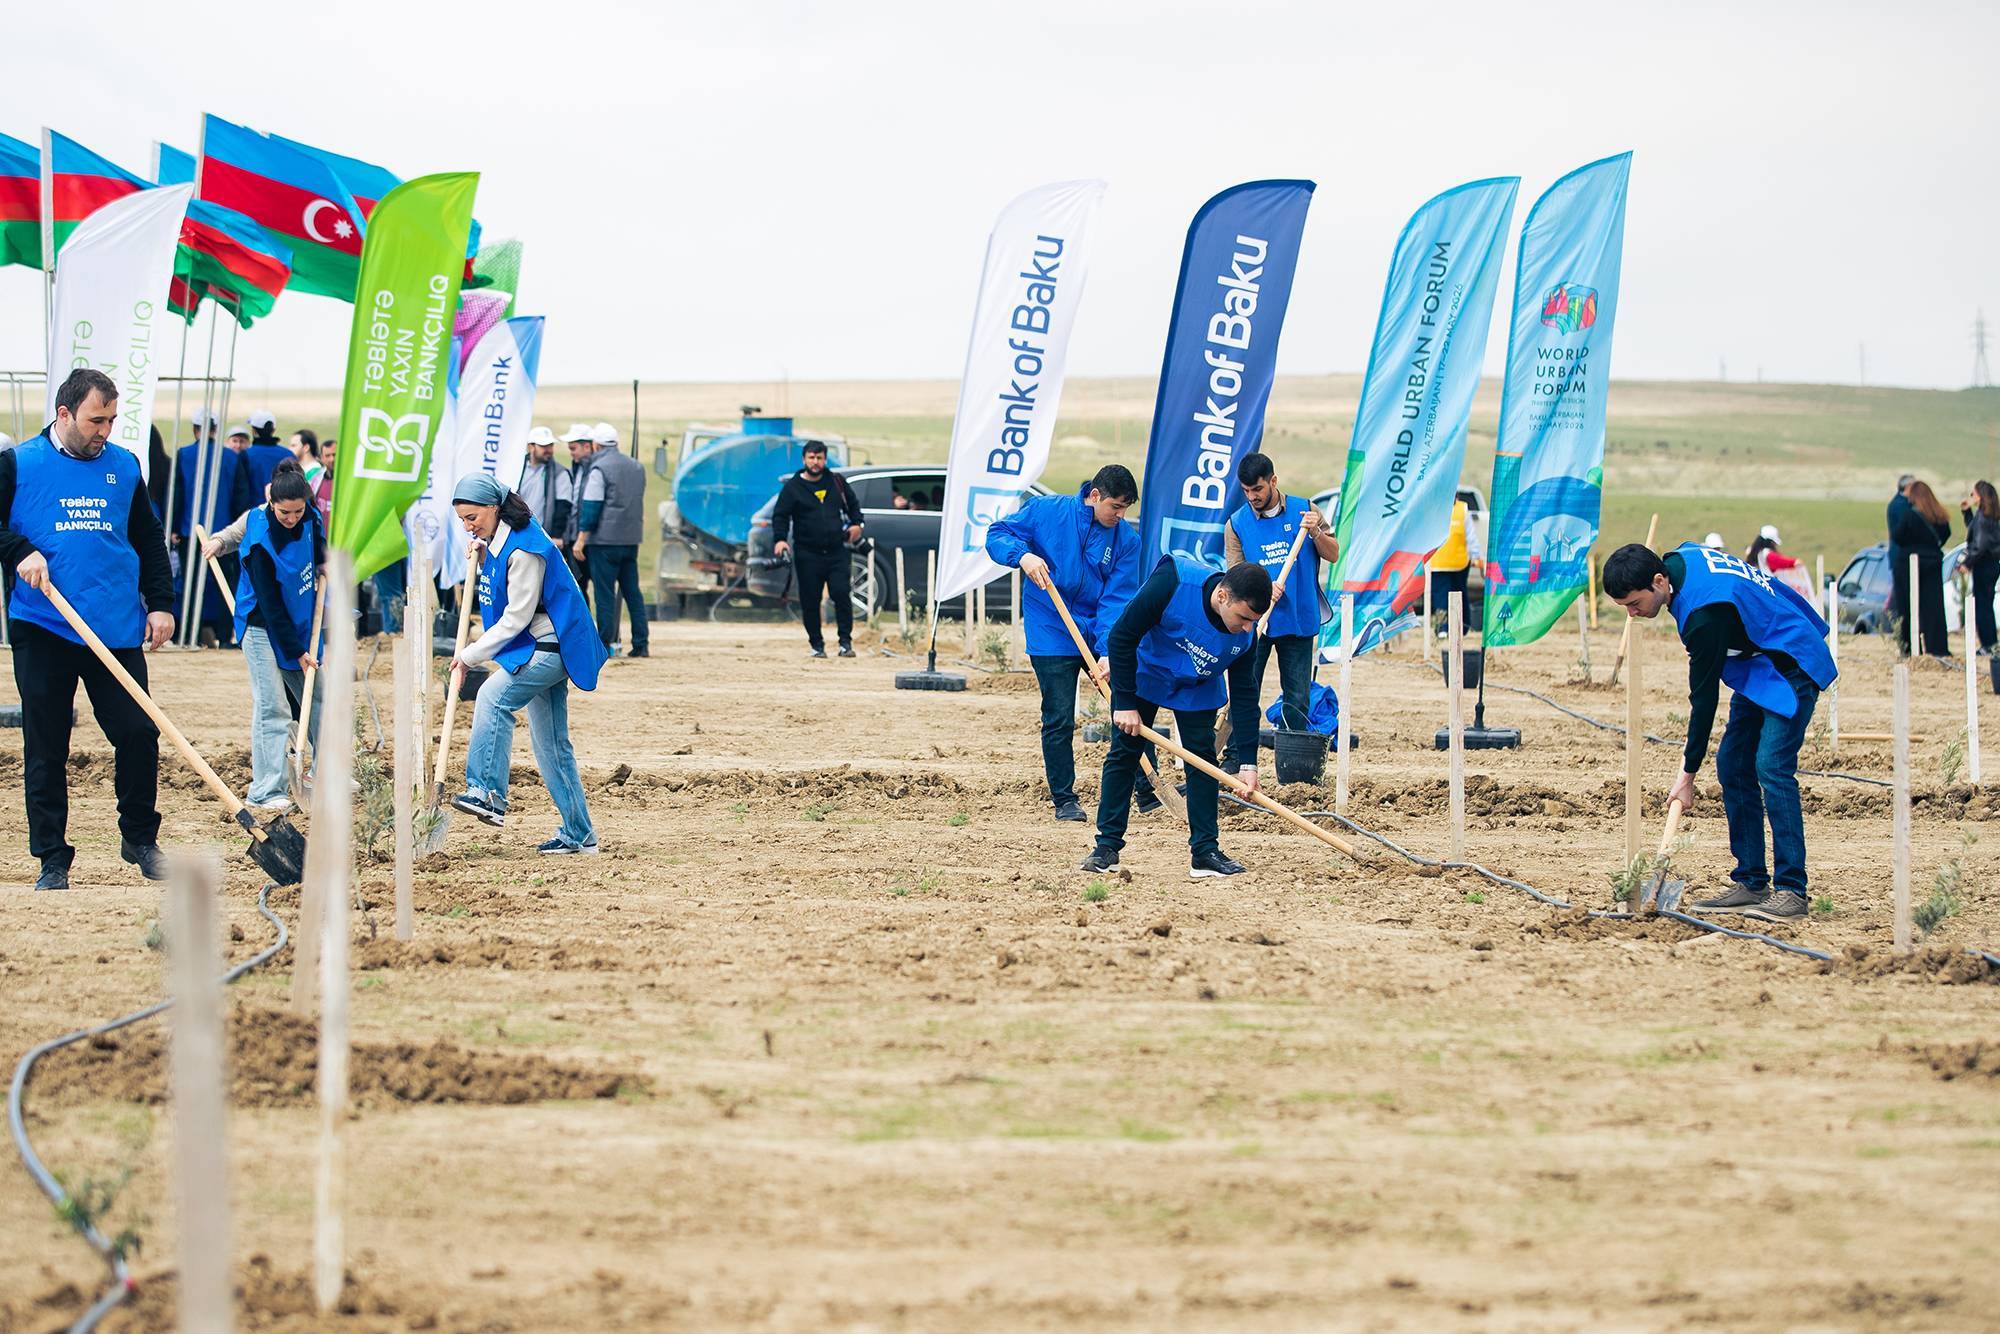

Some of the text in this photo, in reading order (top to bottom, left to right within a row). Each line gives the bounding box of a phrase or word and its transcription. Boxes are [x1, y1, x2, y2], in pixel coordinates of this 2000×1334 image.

[121, 301, 153, 441] BANKÇILIQ
[363, 289, 394, 394] TƏBİƏTƏ
[389, 328, 415, 397] YAXIN
[414, 274, 449, 400] BANKÇILIQ
[986, 234, 1065, 476] Bank of Baku
[1536, 363, 1587, 378] URBAN
[1537, 346, 1589, 361] WORLD
[1181, 234, 1269, 510] Bank of Baku
[1382, 241, 1451, 519] WORLD URBAN FORUM
[1534, 380, 1586, 396] FORUM
[480, 356, 512, 477] uranBank
[1424, 382, 1442, 447] AZERBAIJAN
[55, 520, 113, 532] BANKÇILIQ
[59, 496, 108, 508] TƏBİƏTƏ
[67, 509, 101, 519] YAXIN
